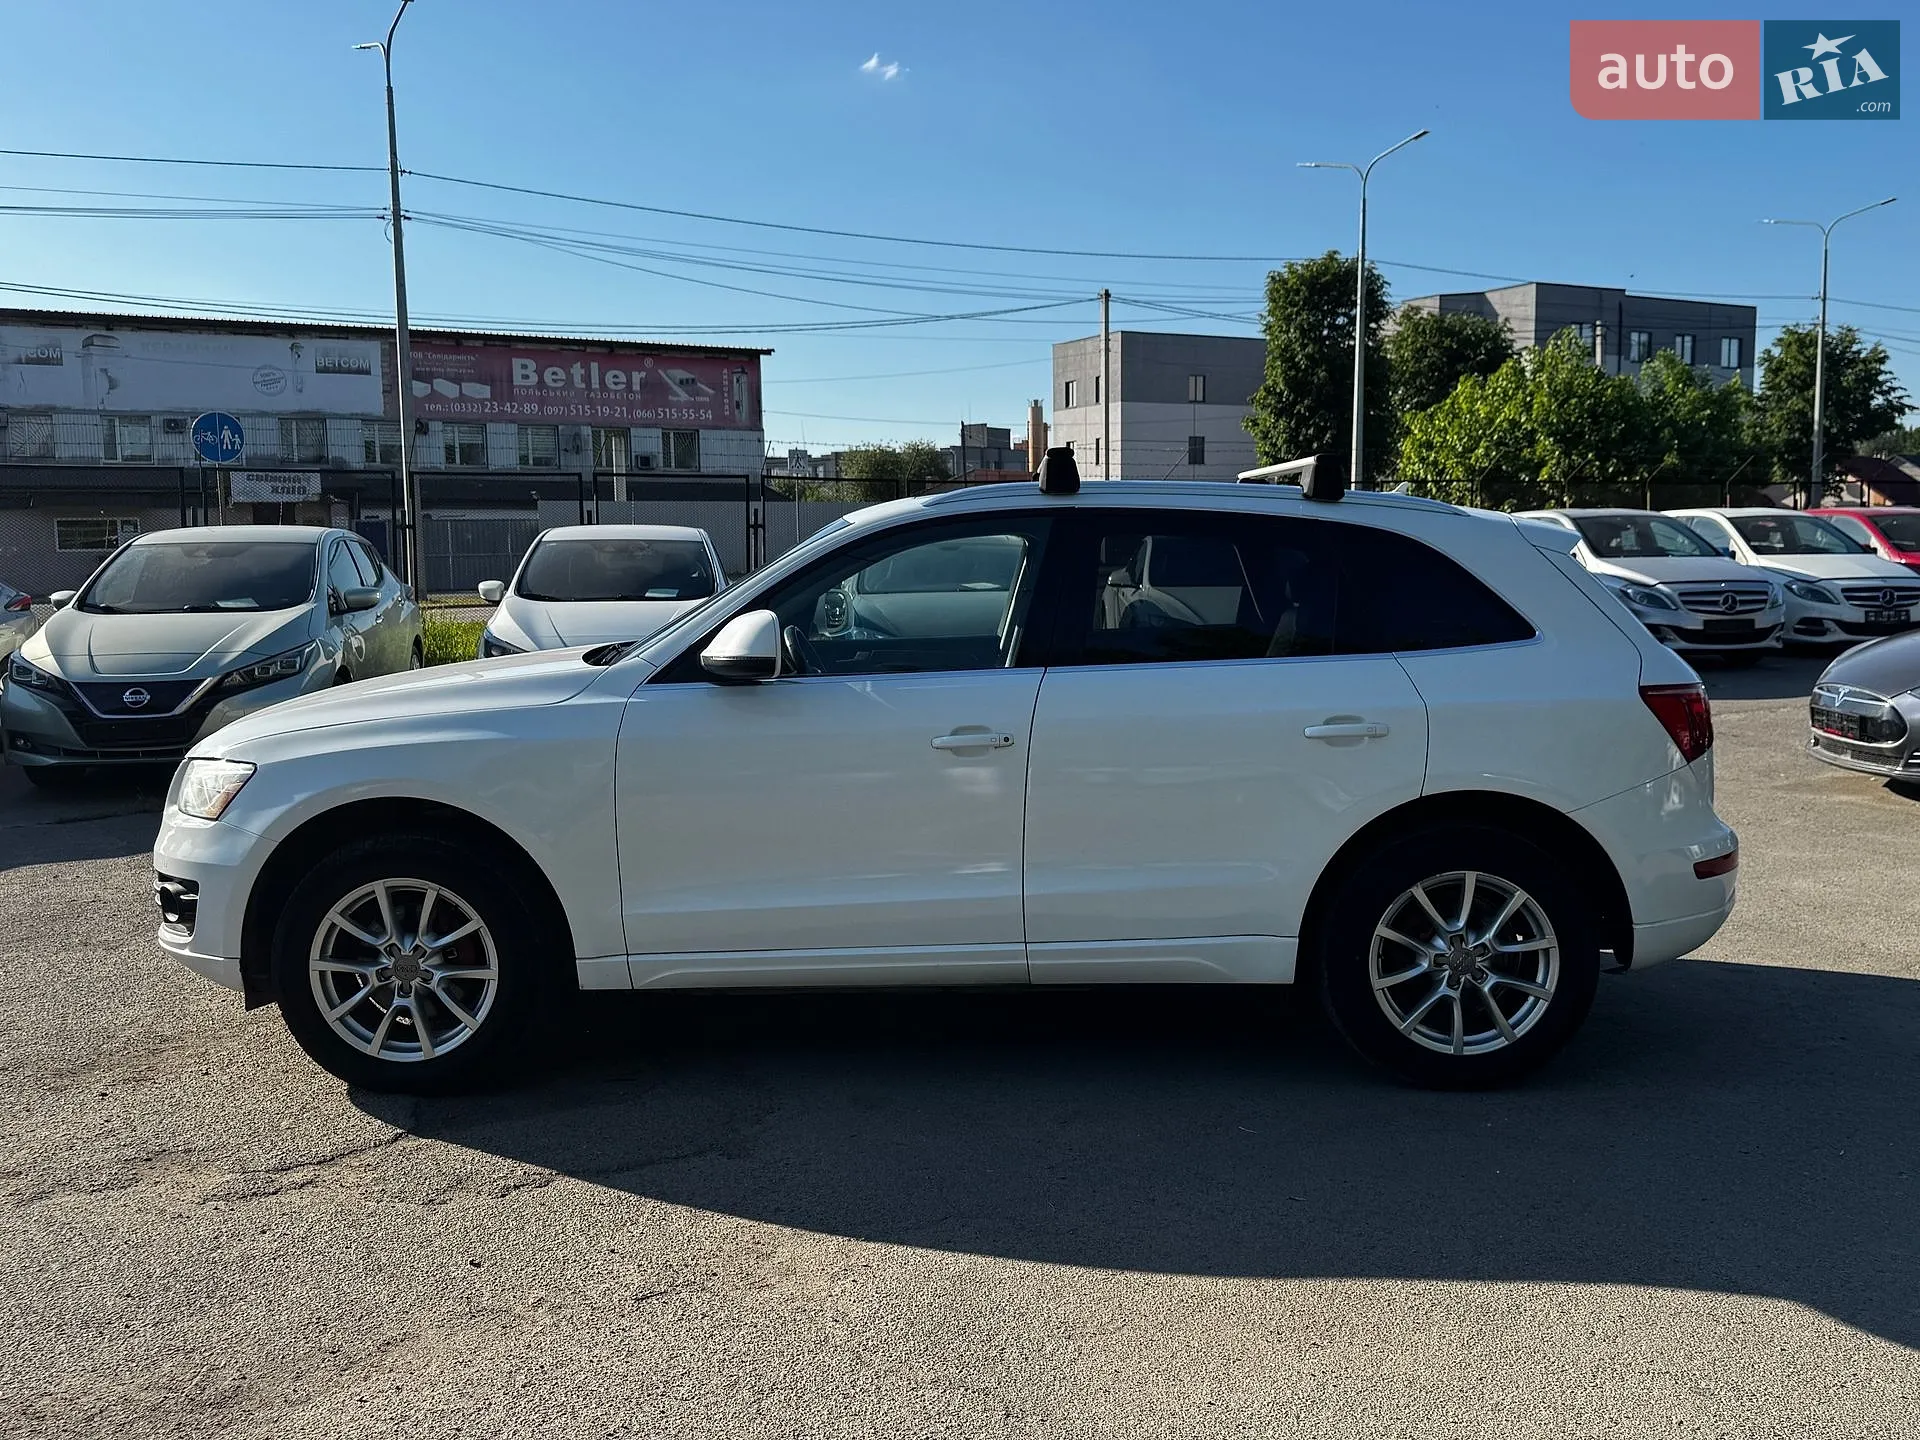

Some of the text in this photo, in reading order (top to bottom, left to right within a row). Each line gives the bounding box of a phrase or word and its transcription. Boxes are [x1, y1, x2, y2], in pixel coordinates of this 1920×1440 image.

[316, 357, 370, 369] BETCOM
[450, 402, 482, 413] (0332)
[657, 407, 712, 420] 515-55-54
